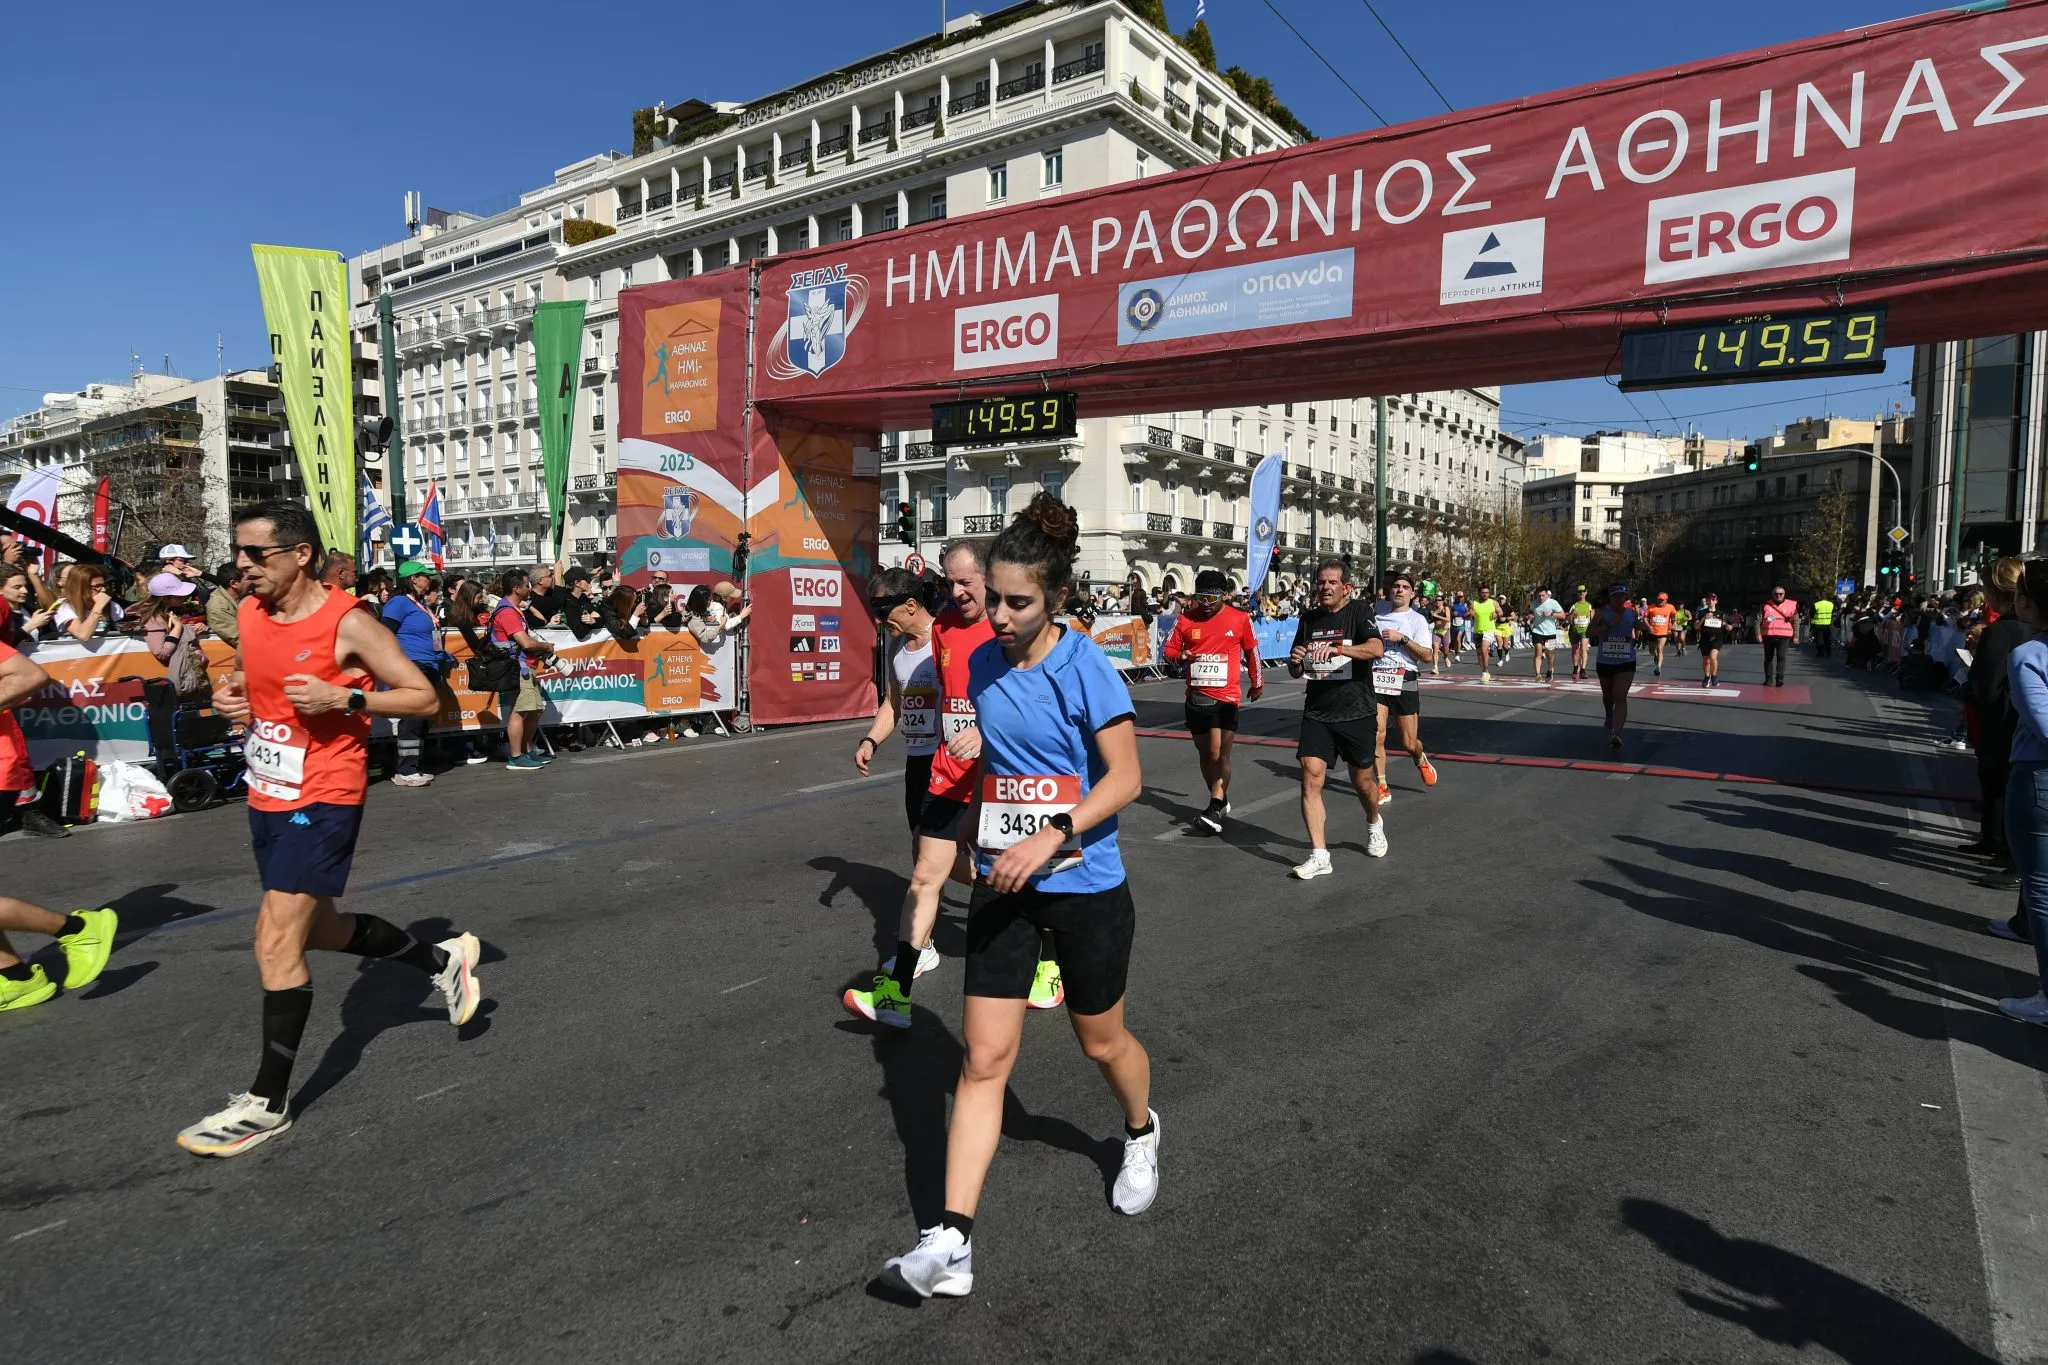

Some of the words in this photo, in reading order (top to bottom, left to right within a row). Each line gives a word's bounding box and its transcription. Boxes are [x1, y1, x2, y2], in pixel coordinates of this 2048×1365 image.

[737, 102, 781, 129] HOTEL
[786, 79, 844, 111] GRANDE
[851, 47, 934, 89] BRETAGNE
[886, 143, 1491, 307] ΗΜΙΜΑΡΑΘΩΝΙΟΣ
[1545, 35, 2048, 199] ΑΘΗΝΑΣ
[1658, 194, 1838, 264] ERGO
[791, 263, 848, 289] ΣΕΓΑΣ
[1169, 291, 1208, 305] ΔΗΜΟΣ
[1441, 286, 1496, 299] ΠΕΡΙΦΕΡΕΙΑ
[1500, 280, 1541, 292] ΑΤΤΙΚΗΣ
[1168, 303, 1228, 320] ΑΘΗΝΑΙΩΝ
[961, 311, 1051, 354] ERGO
[672, 340, 708, 356] ΑΘΗΝΑΣ
[1695, 315, 1876, 372] 1.49.59
[677, 358, 703, 375] ΗΜΙ-
[664, 410, 691, 424] ERGO
[967, 400, 1059, 435] 1.49.59
[659, 453, 695, 472] 2025
[809, 475, 845, 488] ΑΘΗΝΑΣ
[803, 537, 829, 550] ERGO
[793, 577, 839, 598] ERGO
[667, 655, 693, 663] ATHENS
[669, 665, 691, 675] HALF
[1198, 665, 1219, 673] 7270
[540, 673, 637, 693] ΜΑΡΑΘΩΝΙΟΣ
[1376, 675, 1396, 684] 5339
[662, 696, 683, 705] ERGO
[950, 698, 976, 713] ERG
[20, 701, 150, 728] ΡΑΘΩΝΙΟ
[448, 710, 477, 720] ERGO
[996, 778, 1058, 801] ERGO
